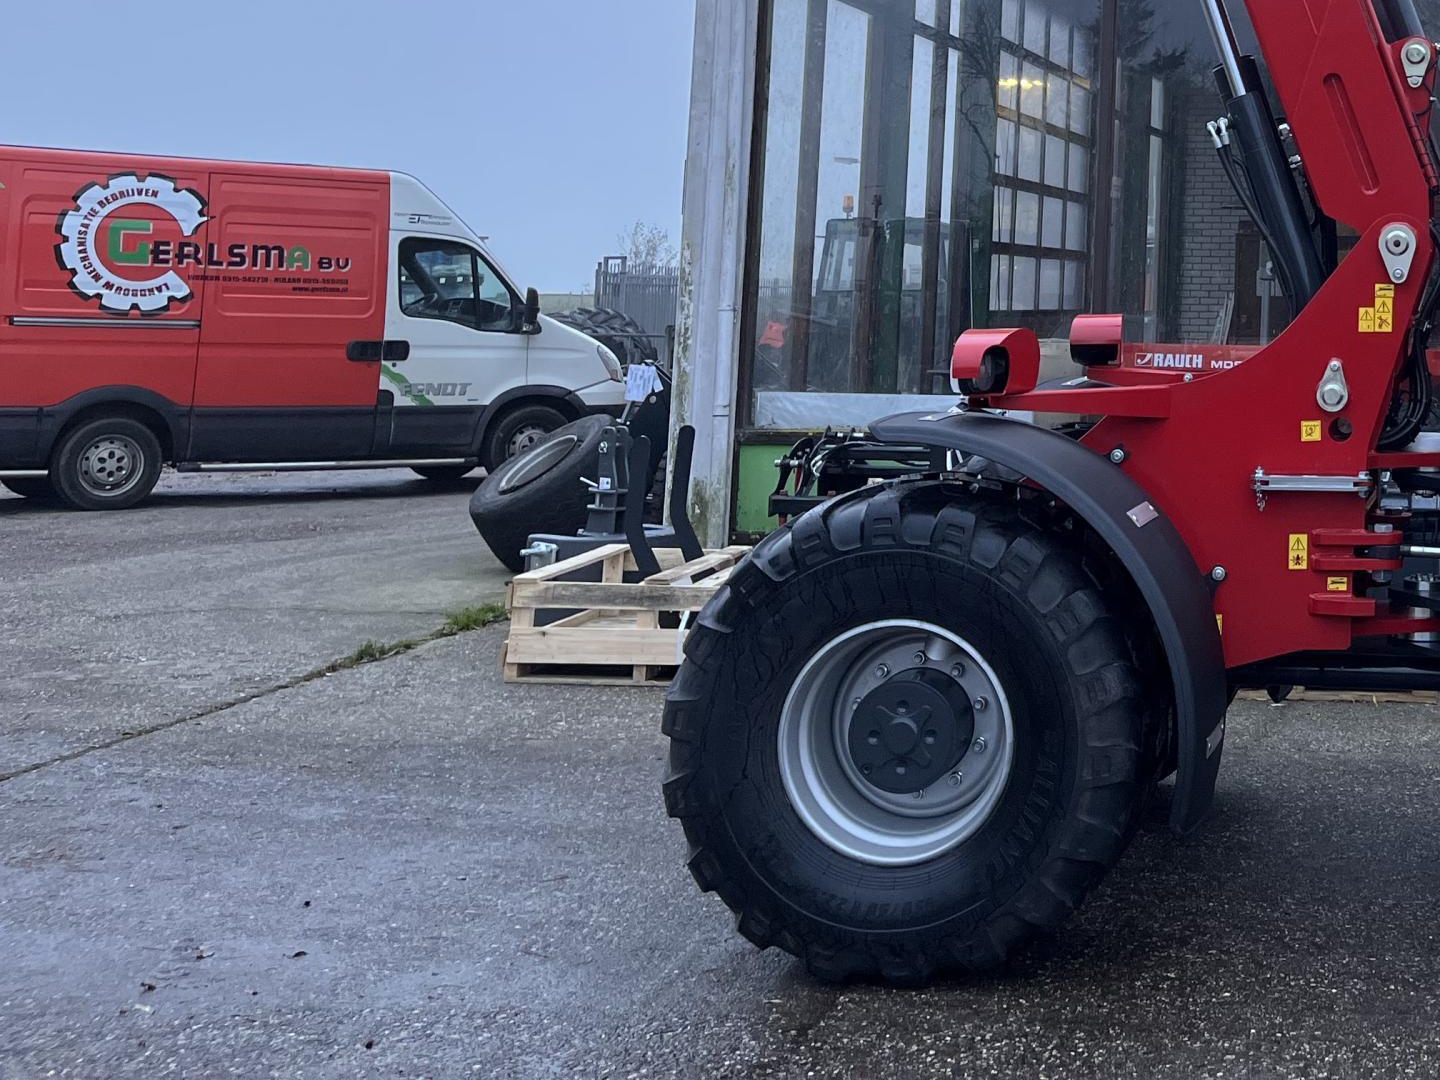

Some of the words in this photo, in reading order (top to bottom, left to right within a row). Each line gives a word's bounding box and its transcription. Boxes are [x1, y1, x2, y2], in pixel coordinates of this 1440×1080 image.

[97, 187, 160, 209] BEDRIJVEN
[76, 207, 104, 283] MECHANISATIE
[317, 256, 352, 273] BV
[102, 279, 171, 298] LANDBOUW
[1153, 353, 1203, 368] RAUCH
[400, 383, 473, 396] FENDT
